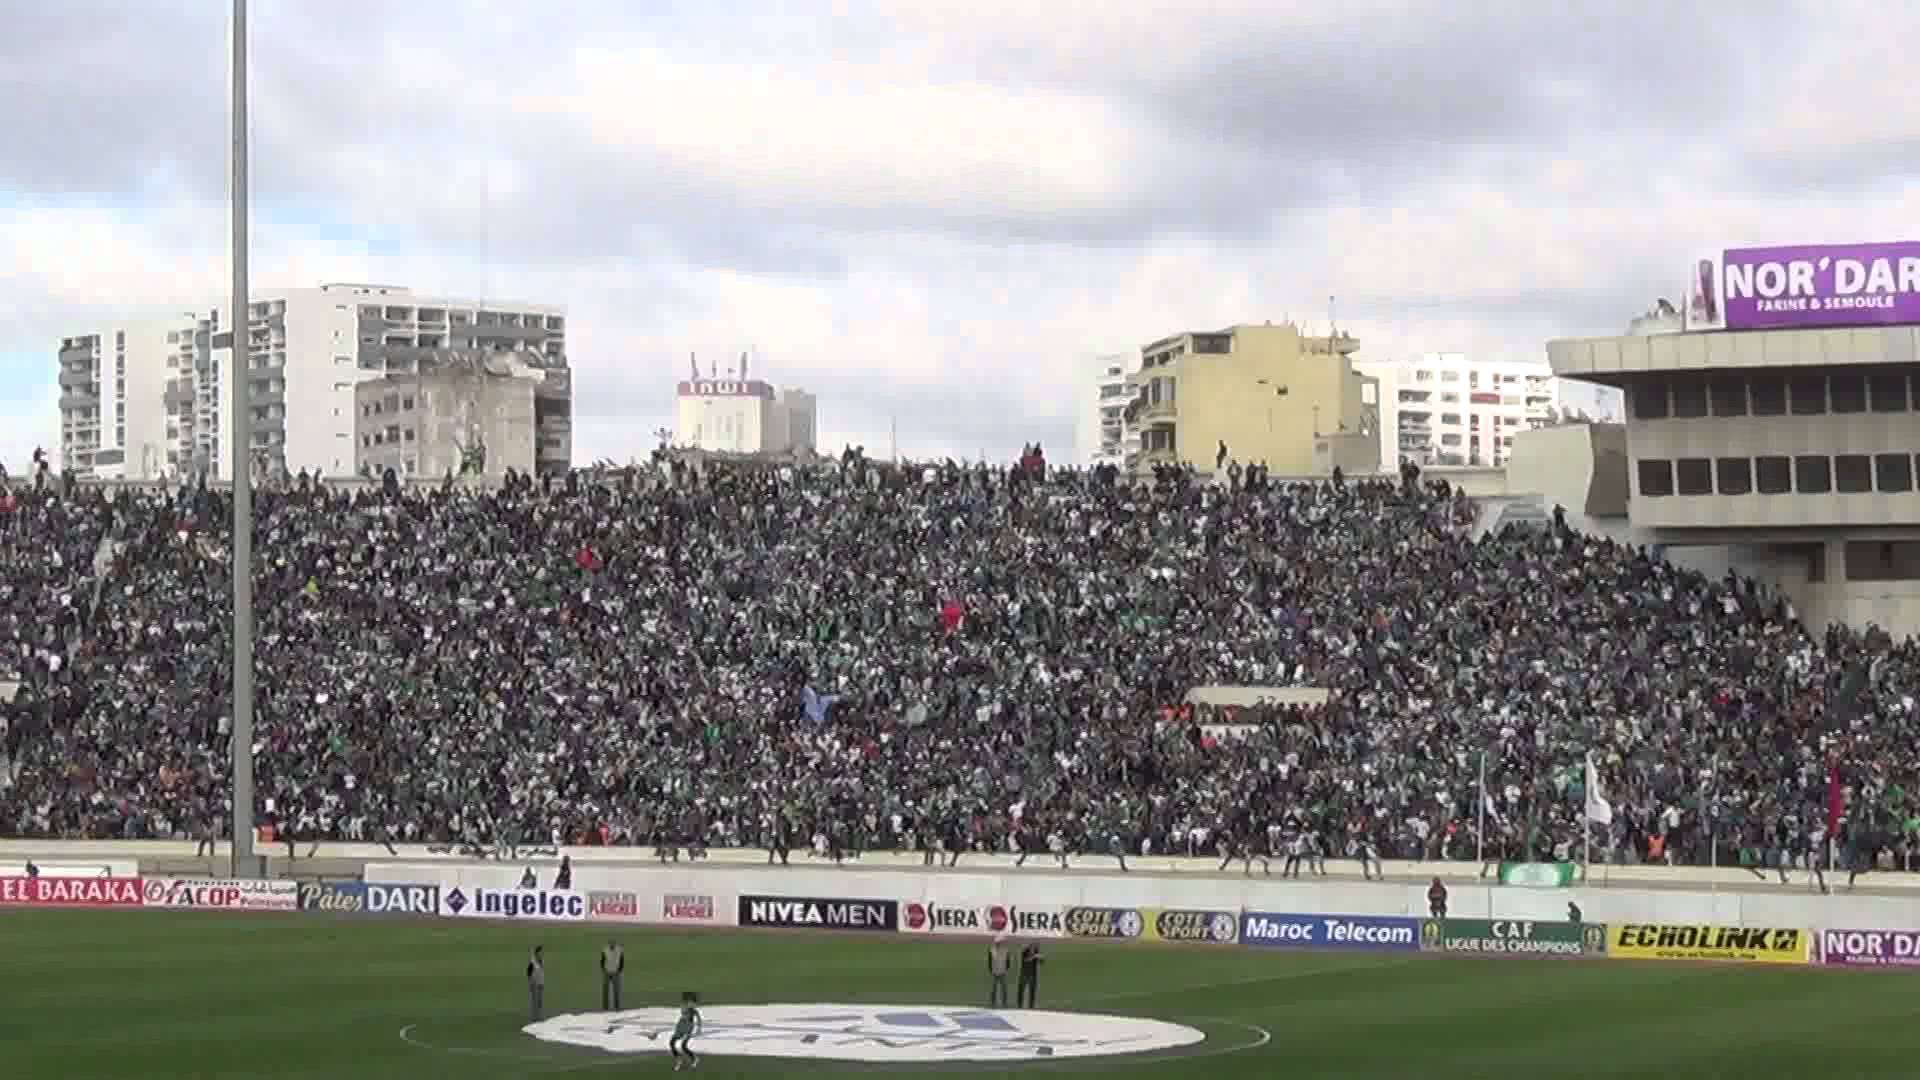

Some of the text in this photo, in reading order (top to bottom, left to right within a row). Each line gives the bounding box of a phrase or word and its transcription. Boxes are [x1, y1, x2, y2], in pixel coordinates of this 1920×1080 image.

[1757, 296, 1896, 312] FARINE & SEMOULE
[2, 879, 142, 902] EL BARAKA
[367, 886, 435, 913] DARI
[475, 888, 584, 917] Ingelec
[750, 900, 887, 926] NIVEA MEN
[927, 901, 979, 930] SIERA
[1010, 905, 1063, 934] SIERA
[1071, 923, 1116, 937] SPORT
[1162, 926, 1211, 939] SPORT
[1246, 918, 1414, 944] Maroc Telecom
[1491, 921, 1535, 938] CAF
[1618, 924, 1771, 950] ECHOLINK
[1445, 937, 1583, 955] LIGUE DES CHAMPIONS
